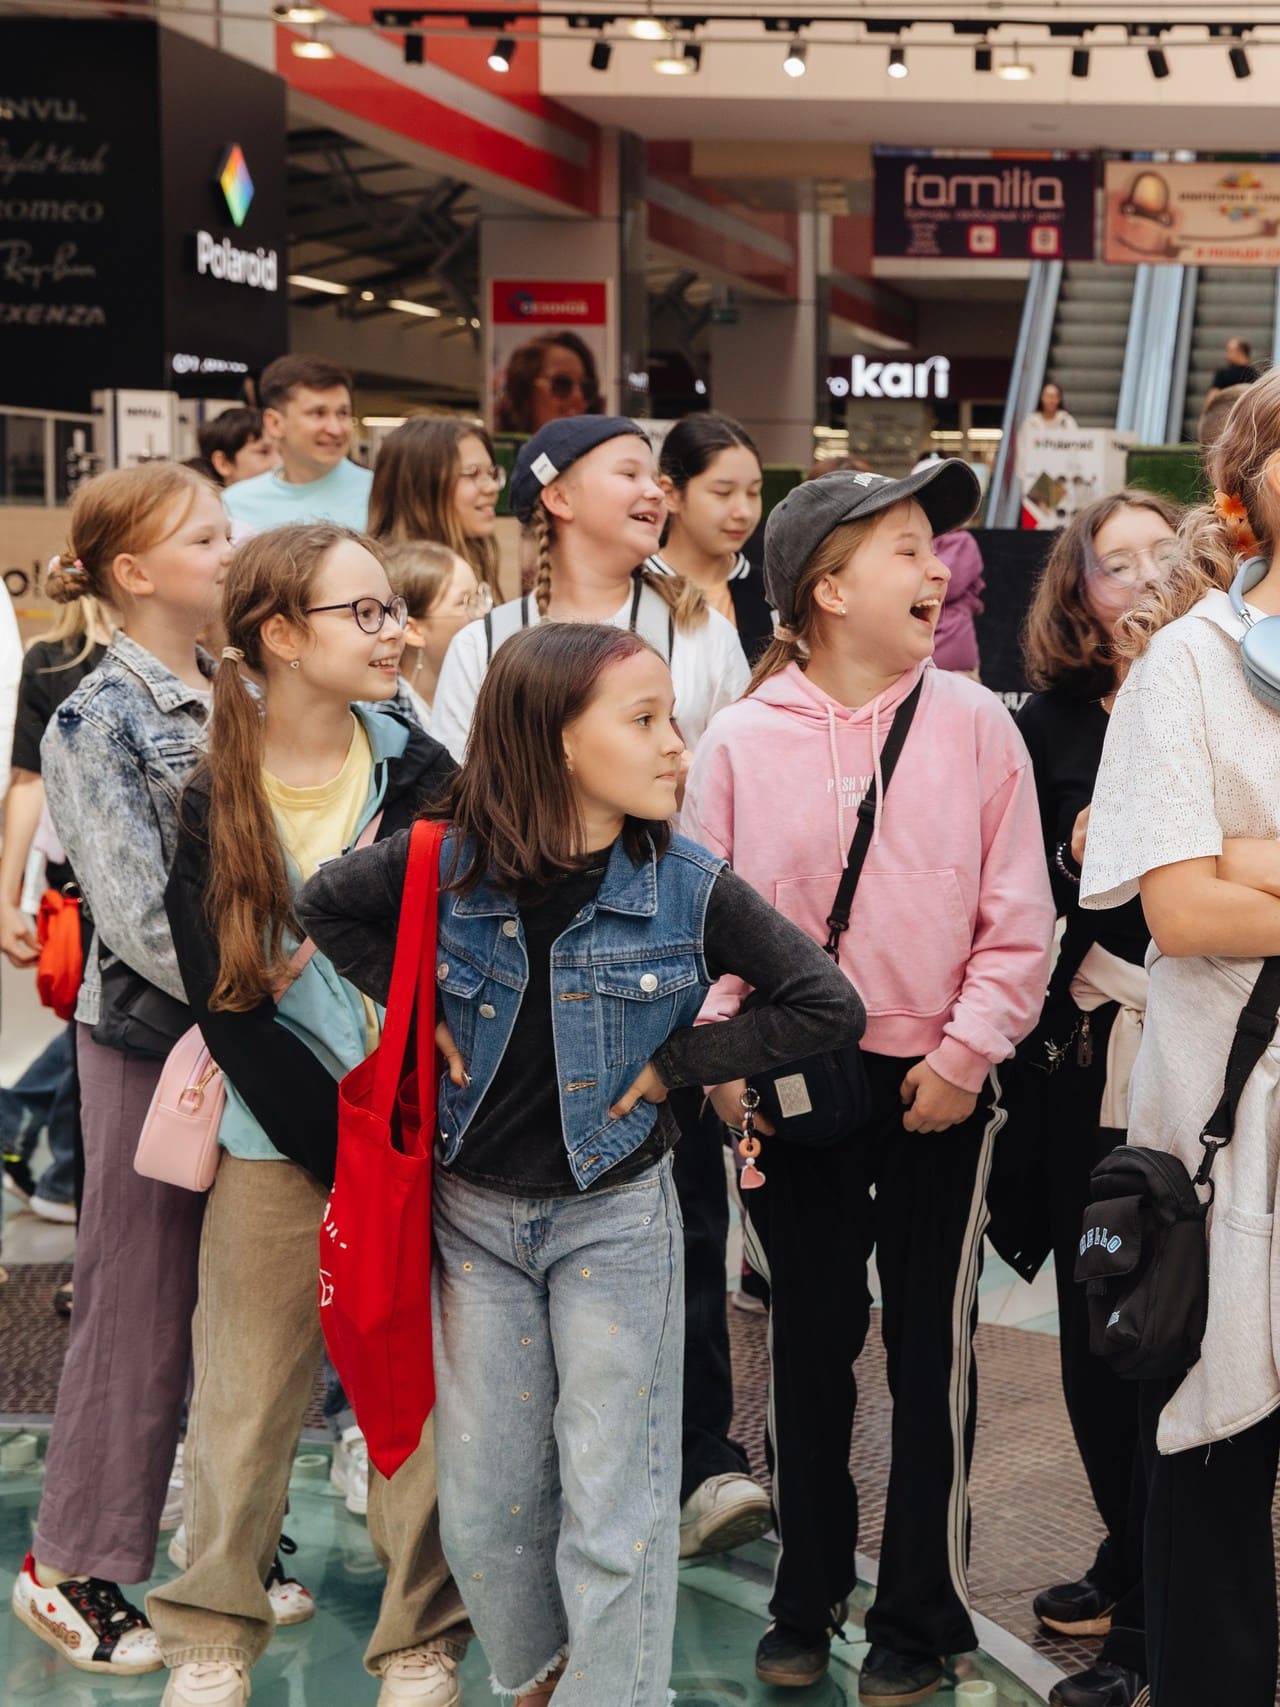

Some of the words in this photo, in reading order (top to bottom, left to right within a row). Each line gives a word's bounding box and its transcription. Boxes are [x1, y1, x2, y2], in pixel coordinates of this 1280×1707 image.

[905, 164, 1064, 209] familia
[197, 230, 278, 292] Polaroid
[851, 354, 950, 399] kari
[827, 775, 856, 793] PSH
[1079, 1226, 1122, 1257] HELLO
